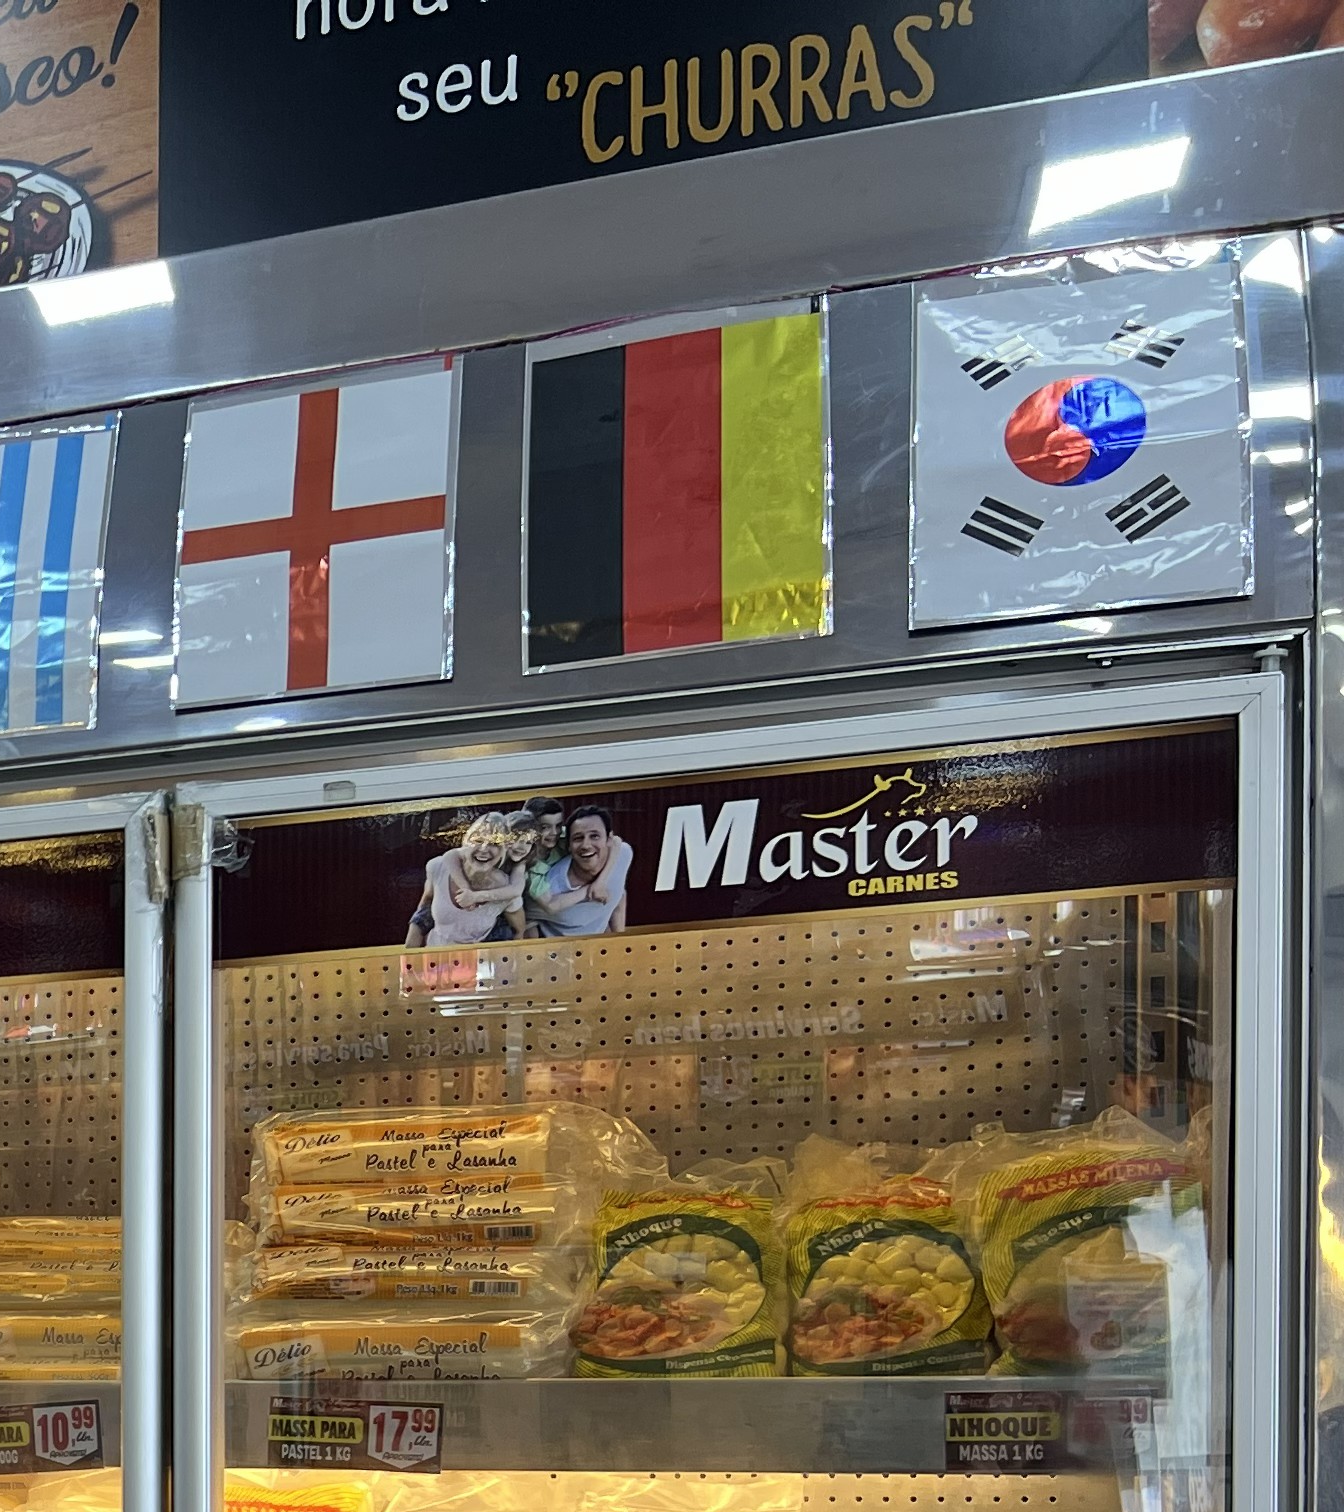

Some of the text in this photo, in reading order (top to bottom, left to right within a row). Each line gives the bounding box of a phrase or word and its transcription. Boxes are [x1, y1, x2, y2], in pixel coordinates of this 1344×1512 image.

[397, 55, 517, 121] seu
[654, 798, 978, 892] Master
[848, 871, 958, 897] CARNES
[365, 1150, 517, 1172] Pastel e Lasanha
[366, 1205, 418, 1224] Pastel
[451, 1204, 523, 1221] Lasanha
[615, 1216, 683, 1249] Nhoque
[815, 1219, 884, 1256] Nhoque
[254, 1333, 487, 1368] Délio Massa Especial
[270, 1417, 356, 1440] MASSA PARA
[950, 1416, 1051, 1437] NHOQUE
[281, 1443, 351, 1461] PASTEL 1 KG
[959, 1444, 1043, 1460] MASSA 1 KG
